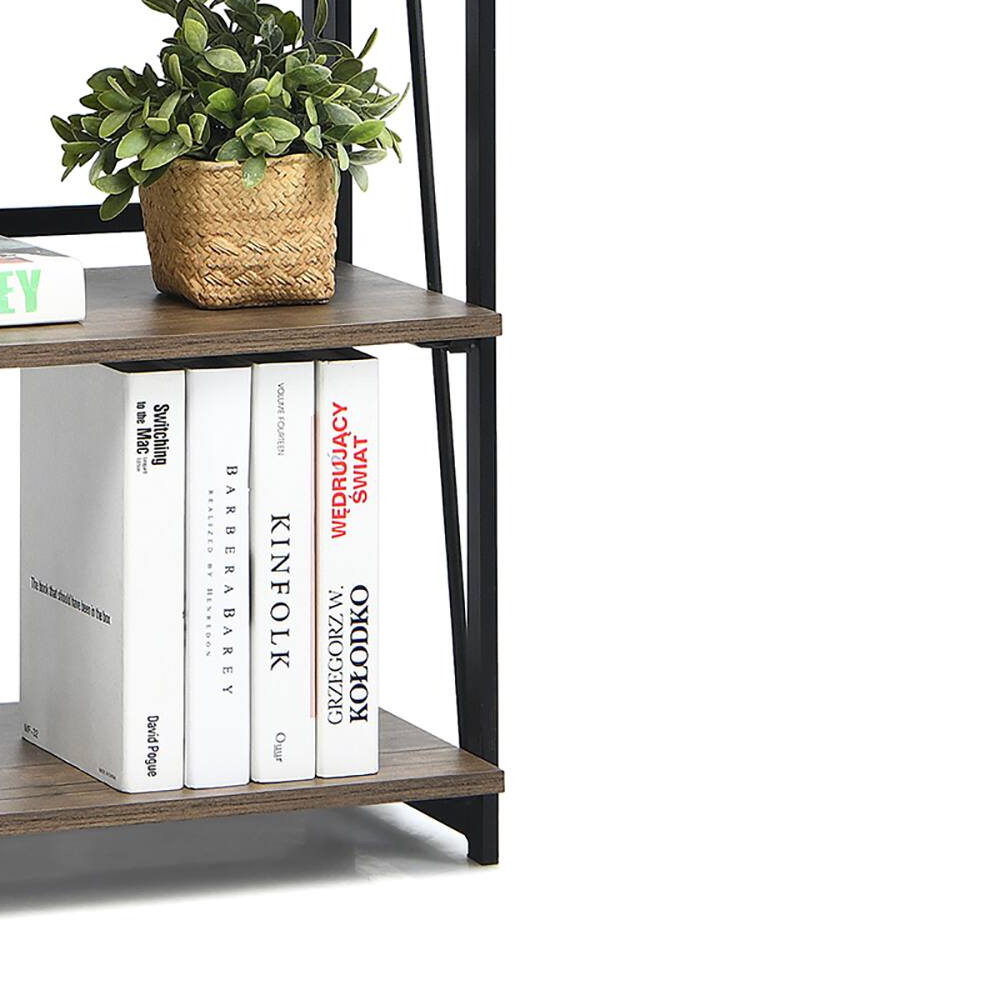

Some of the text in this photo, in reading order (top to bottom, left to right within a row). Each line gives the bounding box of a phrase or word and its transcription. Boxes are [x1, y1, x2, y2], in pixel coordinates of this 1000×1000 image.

[136, 401, 146, 409] to
[136, 411, 147, 424] the
[151, 403, 170, 466] Switching
[136, 427, 152, 455] Mac
[331, 401, 352, 539] WĘDRUJĄCY
[348, 435, 368, 504] ŚWIAT
[207, 563, 214, 578] BY
[270, 513, 291, 671] KINFOLK
[328, 613, 344, 725] GRZEGORZ
[350, 584, 370, 723] KOŁODKO
[144, 715, 160, 777] David Pogue
